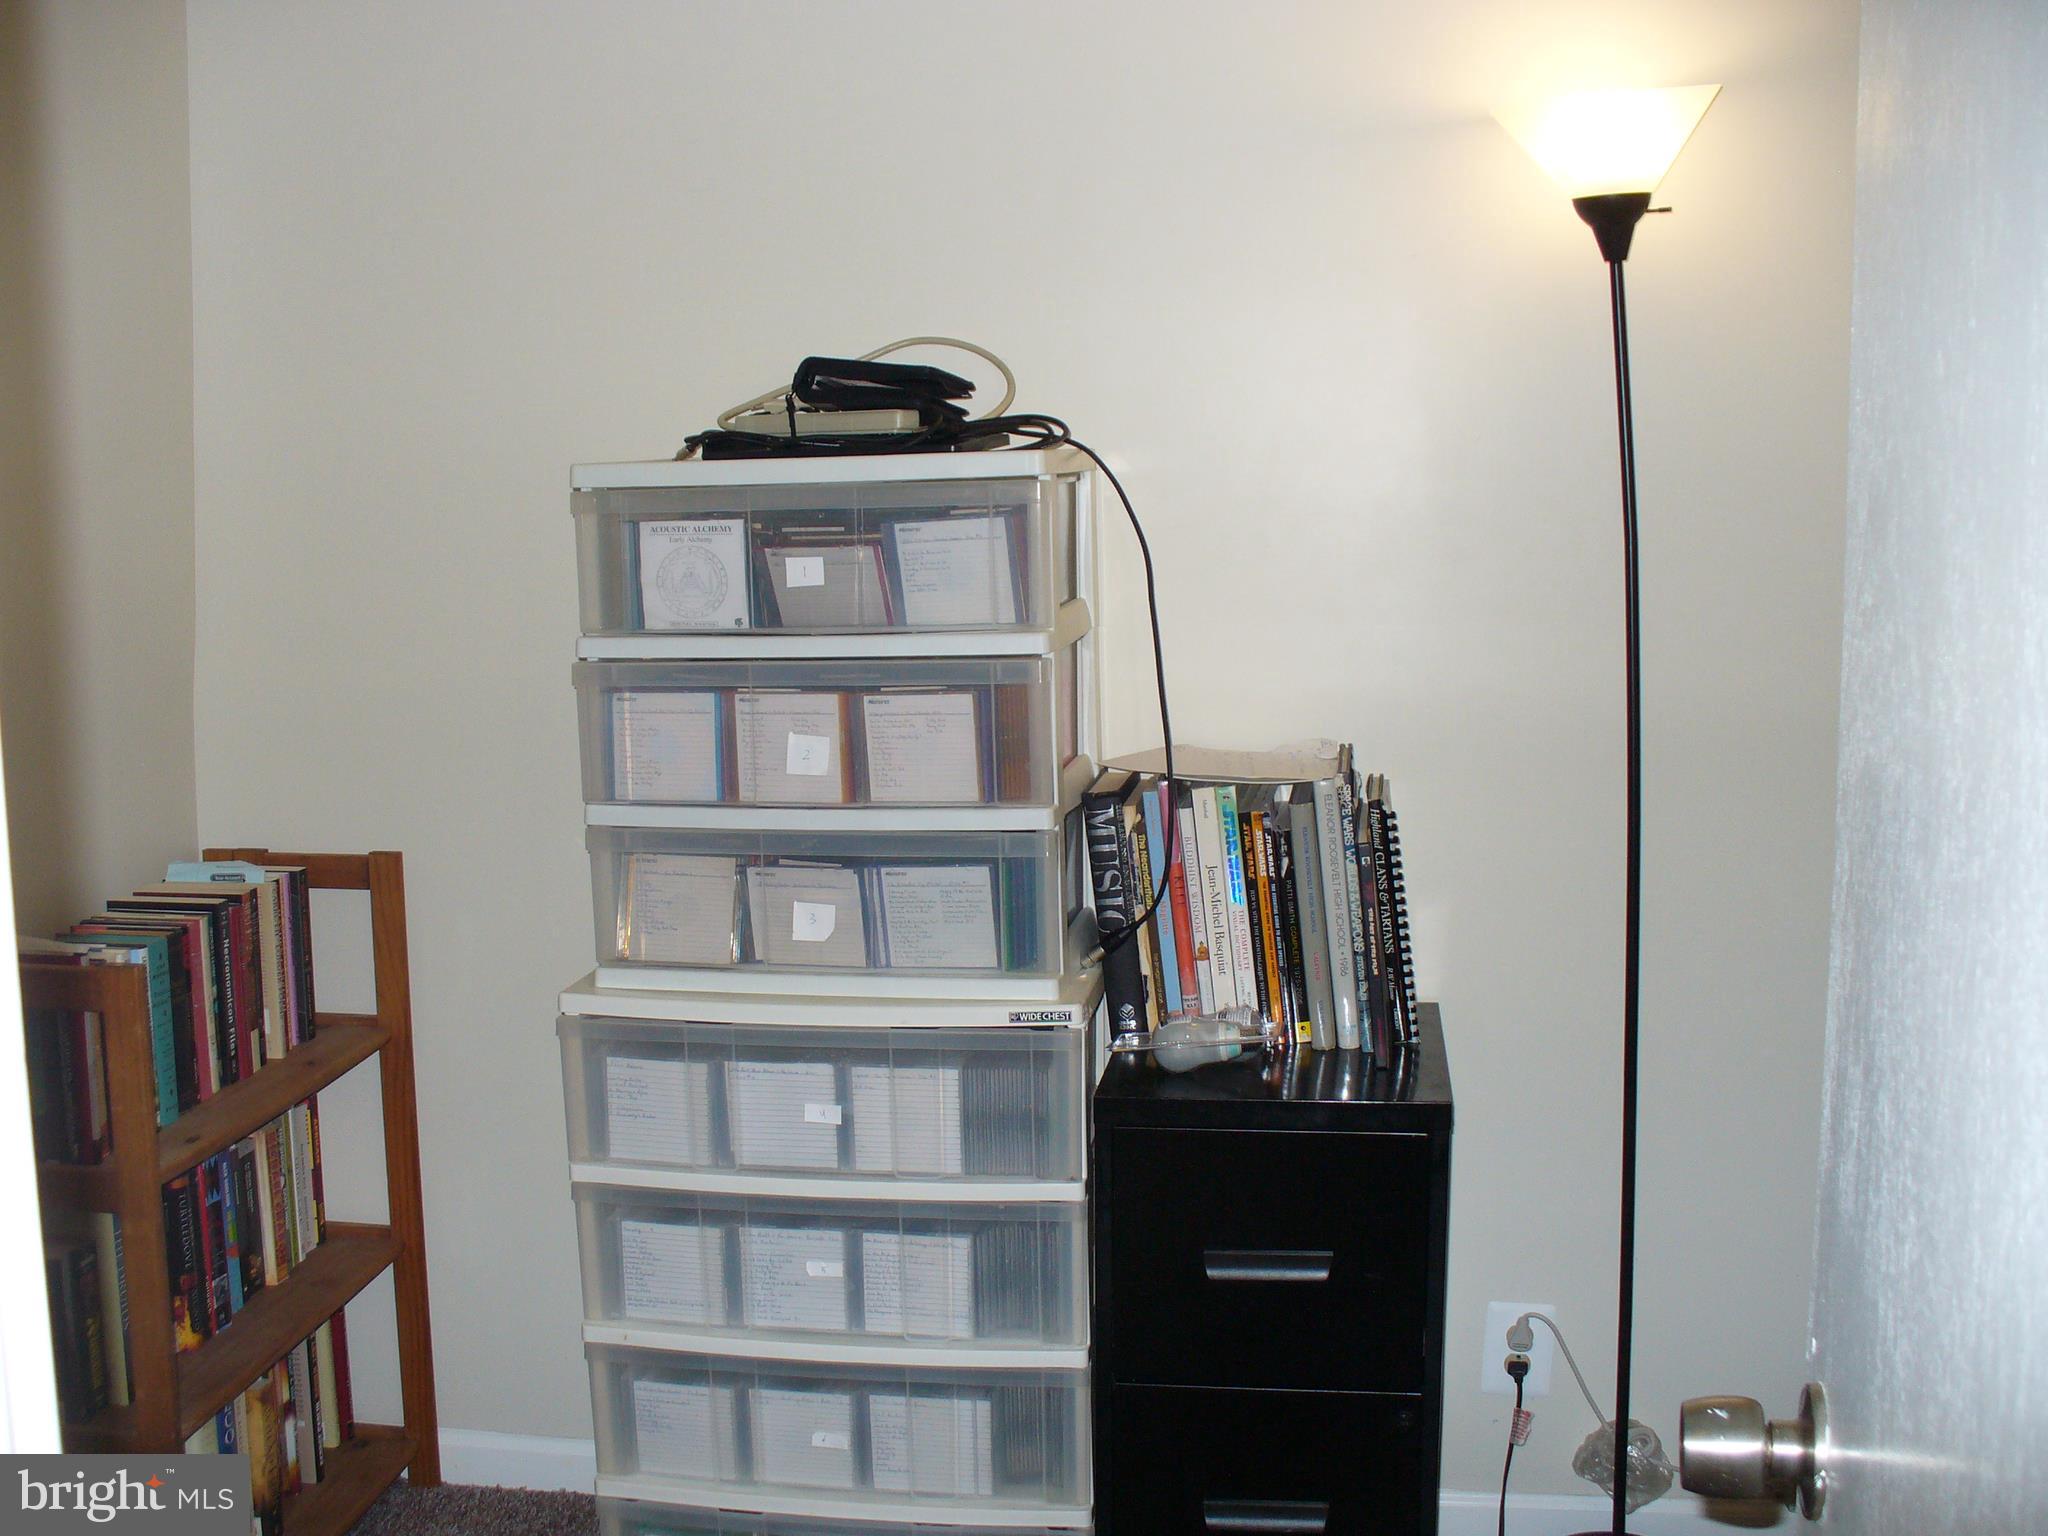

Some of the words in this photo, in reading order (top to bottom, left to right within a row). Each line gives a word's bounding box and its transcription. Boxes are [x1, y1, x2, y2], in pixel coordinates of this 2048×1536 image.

[650, 525, 688, 533] ACOUSTIC
[692, 524, 733, 533] ALCHEMY
[801, 748, 811, 761] 2
[1324, 794, 1335, 834] ELEANOR
[1370, 808, 1383, 849] Highland
[1243, 822, 1251, 852] STAR
[1256, 829, 1265, 853] STAR
[1265, 833, 1274, 856] STAR
[1342, 817, 1354, 846] WARS
[1084, 803, 1127, 933] MUSIC
[1246, 853, 1256, 880] WARS
[1259, 854, 1267, 877] WARS
[1268, 856, 1276, 879] WARS
[1328, 837, 1339, 886] ROOSEVELT
[1375, 851, 1388, 891] CLANS
[1184, 836, 1197, 889] BUDDHIST
[1192, 892, 1203, 933] WISDOM
[1379, 892, 1389, 901] &
[808, 913, 817, 925] 3
[1205, 864, 1221, 930] Jean-Michel
[1213, 932, 1226, 976] Basquiat
[1288, 902, 1296, 924] SMITH
[1336, 912, 1344, 951] SCHOOL
[1380, 903, 1394, 954] TARTANS
[1240, 928, 1250, 971] COMPLETE
[1290, 926, 1300, 963] COMPLETE
[223, 938, 236, 1025] Necronomicon
[1339, 957, 1348, 977] 1986
[1019, 1012, 1042, 1021] WIDE
[1042, 1012, 1070, 1021] CHEST
[227, 1026, 237, 1057] Files
